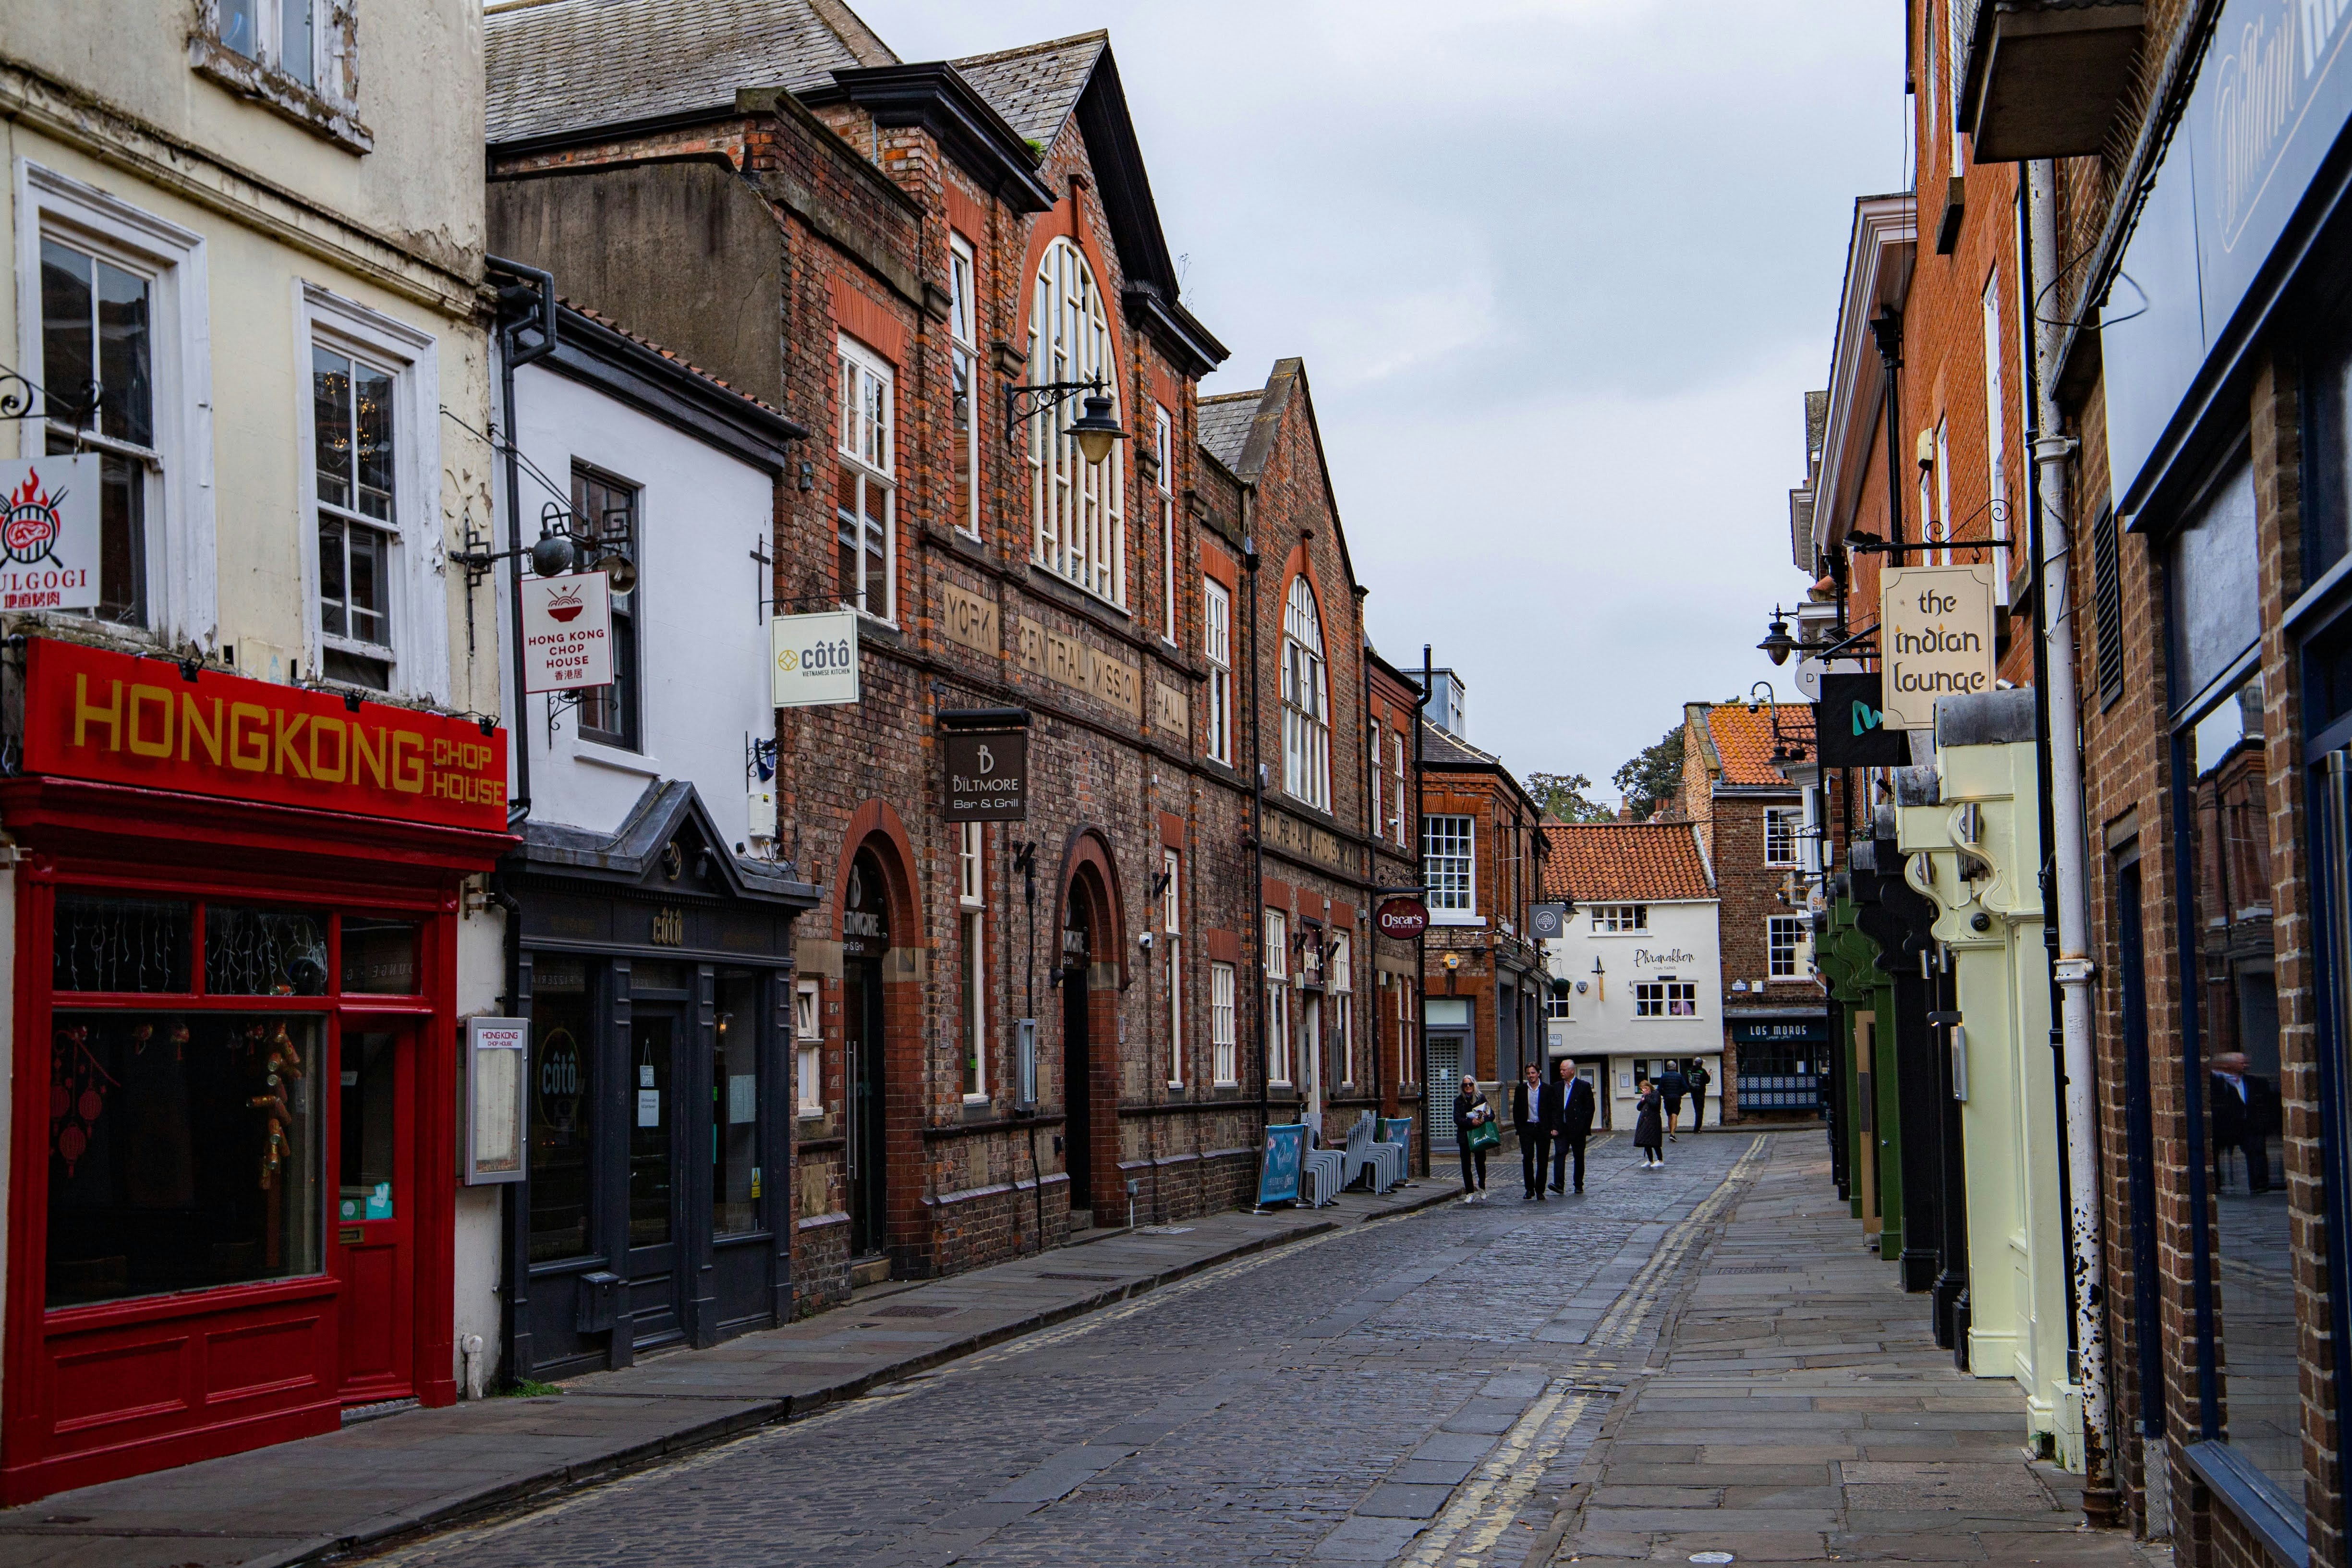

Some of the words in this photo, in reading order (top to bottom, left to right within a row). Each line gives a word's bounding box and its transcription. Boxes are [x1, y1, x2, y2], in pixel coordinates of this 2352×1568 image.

[1917, 589, 1957, 617] the
[529, 633, 565, 646] HONG
[570, 629, 605, 642] KONG
[549, 644, 584, 656] CHOP
[1894, 623, 1982, 655] indian
[546, 656, 589, 669] HOUSE
[801, 638, 849, 669] côtô
[1019, 625, 1085, 682] CENTRAL
[1092, 656, 1140, 709] MISSION
[554, 669, 582, 681] 香港居
[1892, 661, 1986, 695] lounge
[1156, 681, 1184, 729] HALL
[432, 737, 492, 771] CHOP
[432, 771, 506, 807] HOUSE
[952, 775, 1018, 792] BILTMORE
[954, 800, 977, 809] Bar
[981, 799, 992, 808] &
[994, 798, 1018, 808] Grill
[1261, 810, 1289, 846] ECTURE
[1314, 833, 1328, 861] AND
[653, 906, 683, 946] côtô
[844, 911, 880, 937] LTMORE
[1382, 913, 1423, 927] Oscar's
[1634, 948, 1696, 968] Phranakhon
[1750, 1025, 1767, 1035] LOS
[1773, 1025, 1807, 1035] MOROS
[543, 1050, 576, 1094] côtô
